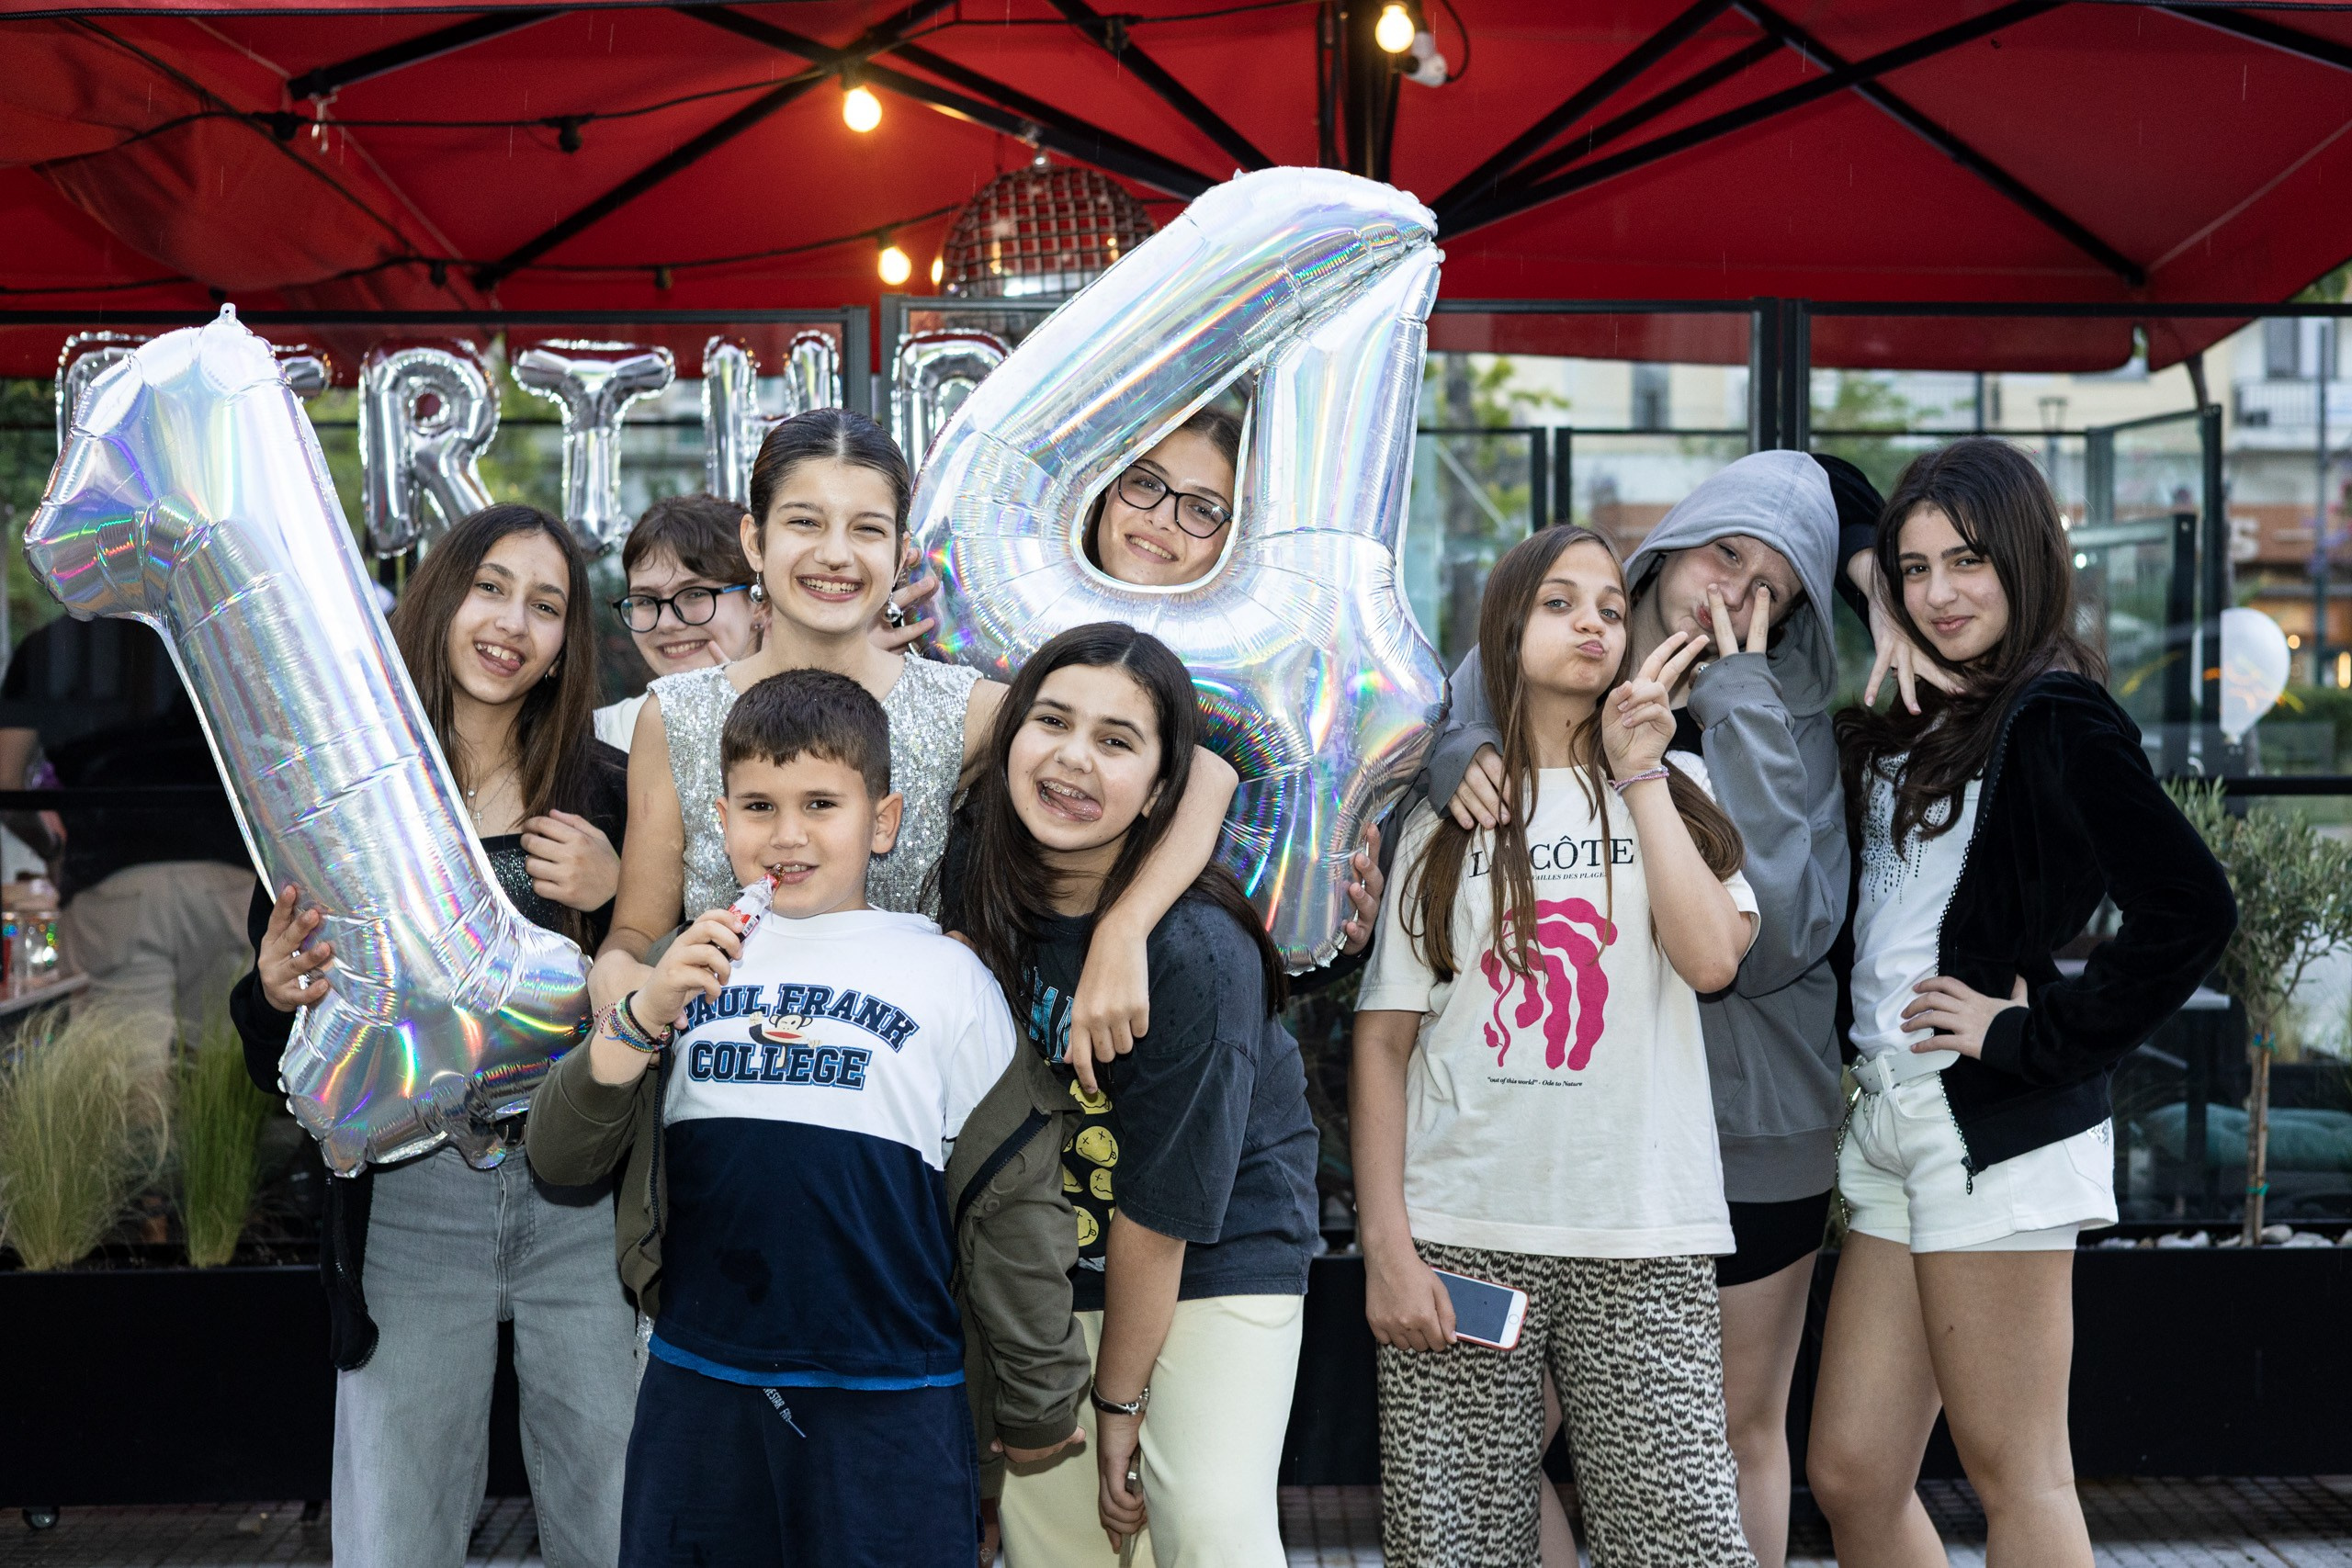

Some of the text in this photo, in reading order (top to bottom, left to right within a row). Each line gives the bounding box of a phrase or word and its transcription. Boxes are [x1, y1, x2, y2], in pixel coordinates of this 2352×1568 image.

[1529, 835, 1634, 870] CÔTE
[1579, 871, 1607, 879] PLAGE
[774, 983, 920, 1053] FRANK
[689, 1041, 873, 1090] COLLEGE
